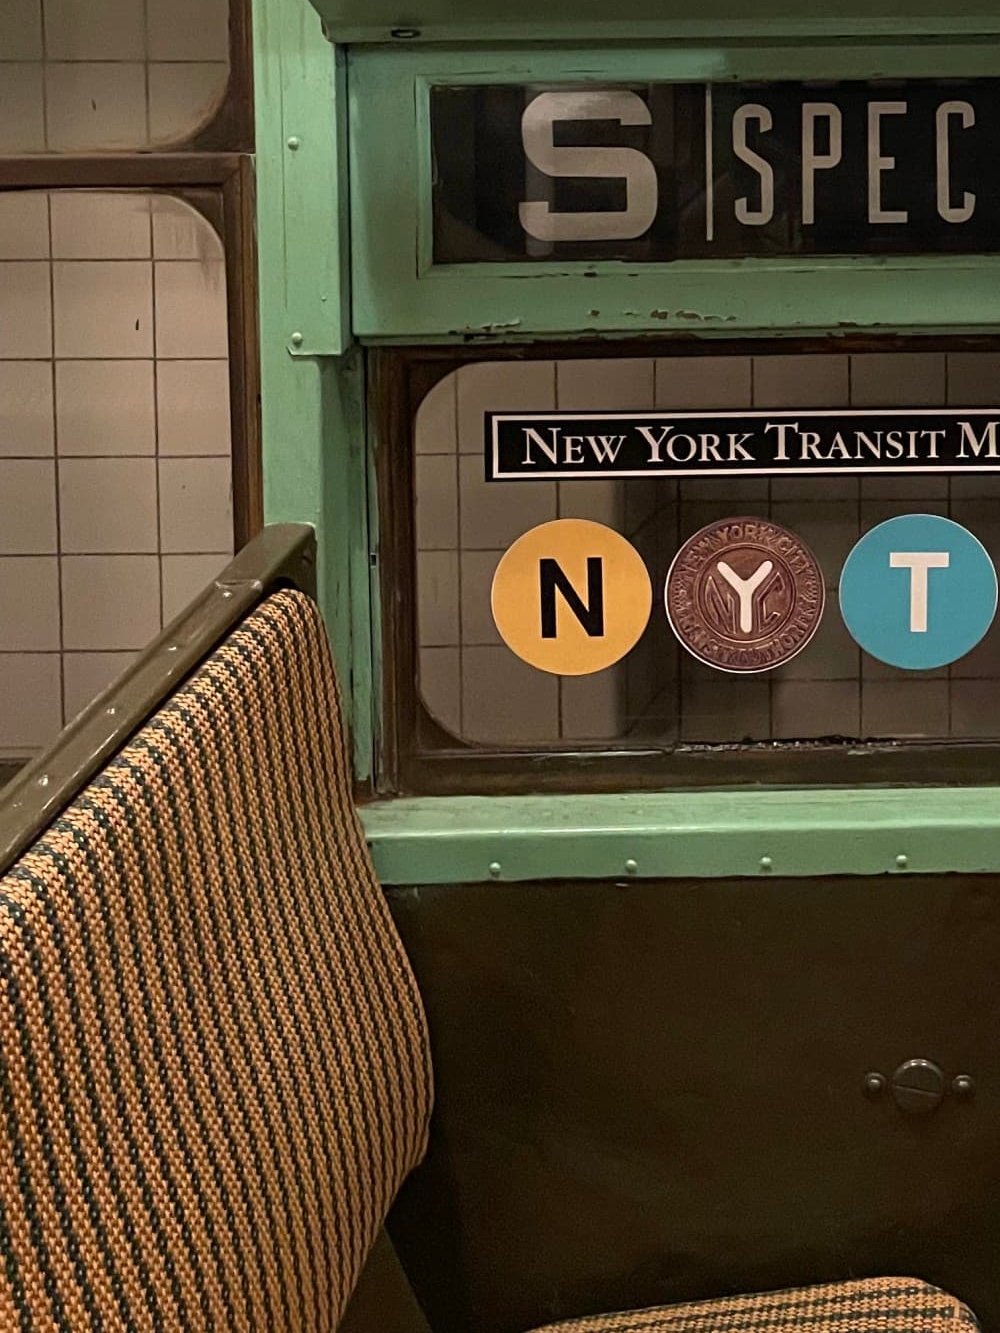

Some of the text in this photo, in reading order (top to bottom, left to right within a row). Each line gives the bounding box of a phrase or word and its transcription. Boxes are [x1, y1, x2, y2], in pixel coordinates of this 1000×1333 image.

[518, 90, 658, 242] S
[538, 556, 605, 639] N
[890, 552, 950, 633] T
